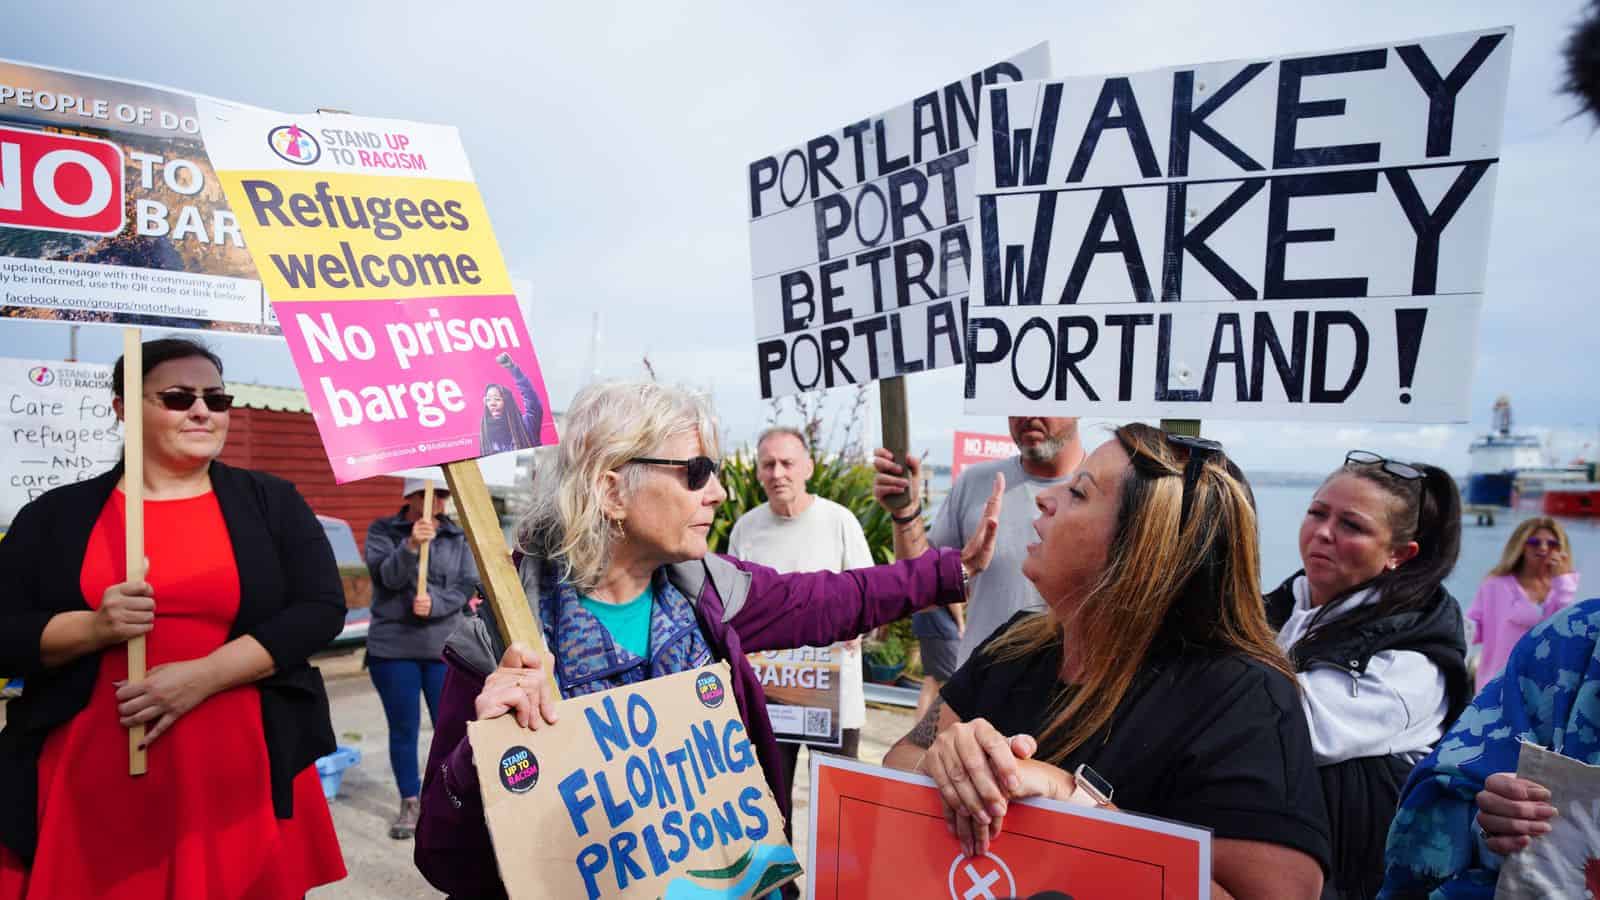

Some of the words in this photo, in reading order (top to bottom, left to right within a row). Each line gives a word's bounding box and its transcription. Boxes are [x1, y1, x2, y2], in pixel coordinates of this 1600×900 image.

[0, 85, 110, 120] PEOPLE
[116, 103, 152, 124] OF
[990, 33, 1507, 188] WAKEY
[321, 128, 381, 149] STAND
[384, 133, 410, 151] UP
[327, 148, 355, 166] TO
[358, 150, 427, 170] RACISM
[130, 152, 204, 196] TO
[136, 199, 245, 248] BAR
[241, 179, 470, 240] Refugees
[814, 150, 970, 263] PORT
[979, 162, 1491, 306] WAKEY
[13, 273, 28, 282] be
[89, 281, 109, 289] use
[111, 280, 129, 289] the
[131, 282, 148, 292] QR
[151, 284, 176, 295] code
[58, 267, 101, 279] engage
[104, 270, 128, 280] with
[131, 271, 149, 281] the
[270, 241, 482, 289] welcome
[296, 312, 375, 363] No
[388, 308, 520, 369] prison
[60, 379, 72, 388] TO
[320, 376, 465, 428] barge
[9, 394, 64, 416] Care
[13, 425, 121, 453] refugees
[11, 474, 61, 487] care
[584, 693, 657, 762] NO
[502, 751, 528, 768] STAND
[505, 765, 517, 776] UP
[517, 759, 529, 770] TO
[507, 764, 538, 785] RACISM
[558, 719, 756, 838] FLOATING
[576, 786, 769, 900] PRISONS
